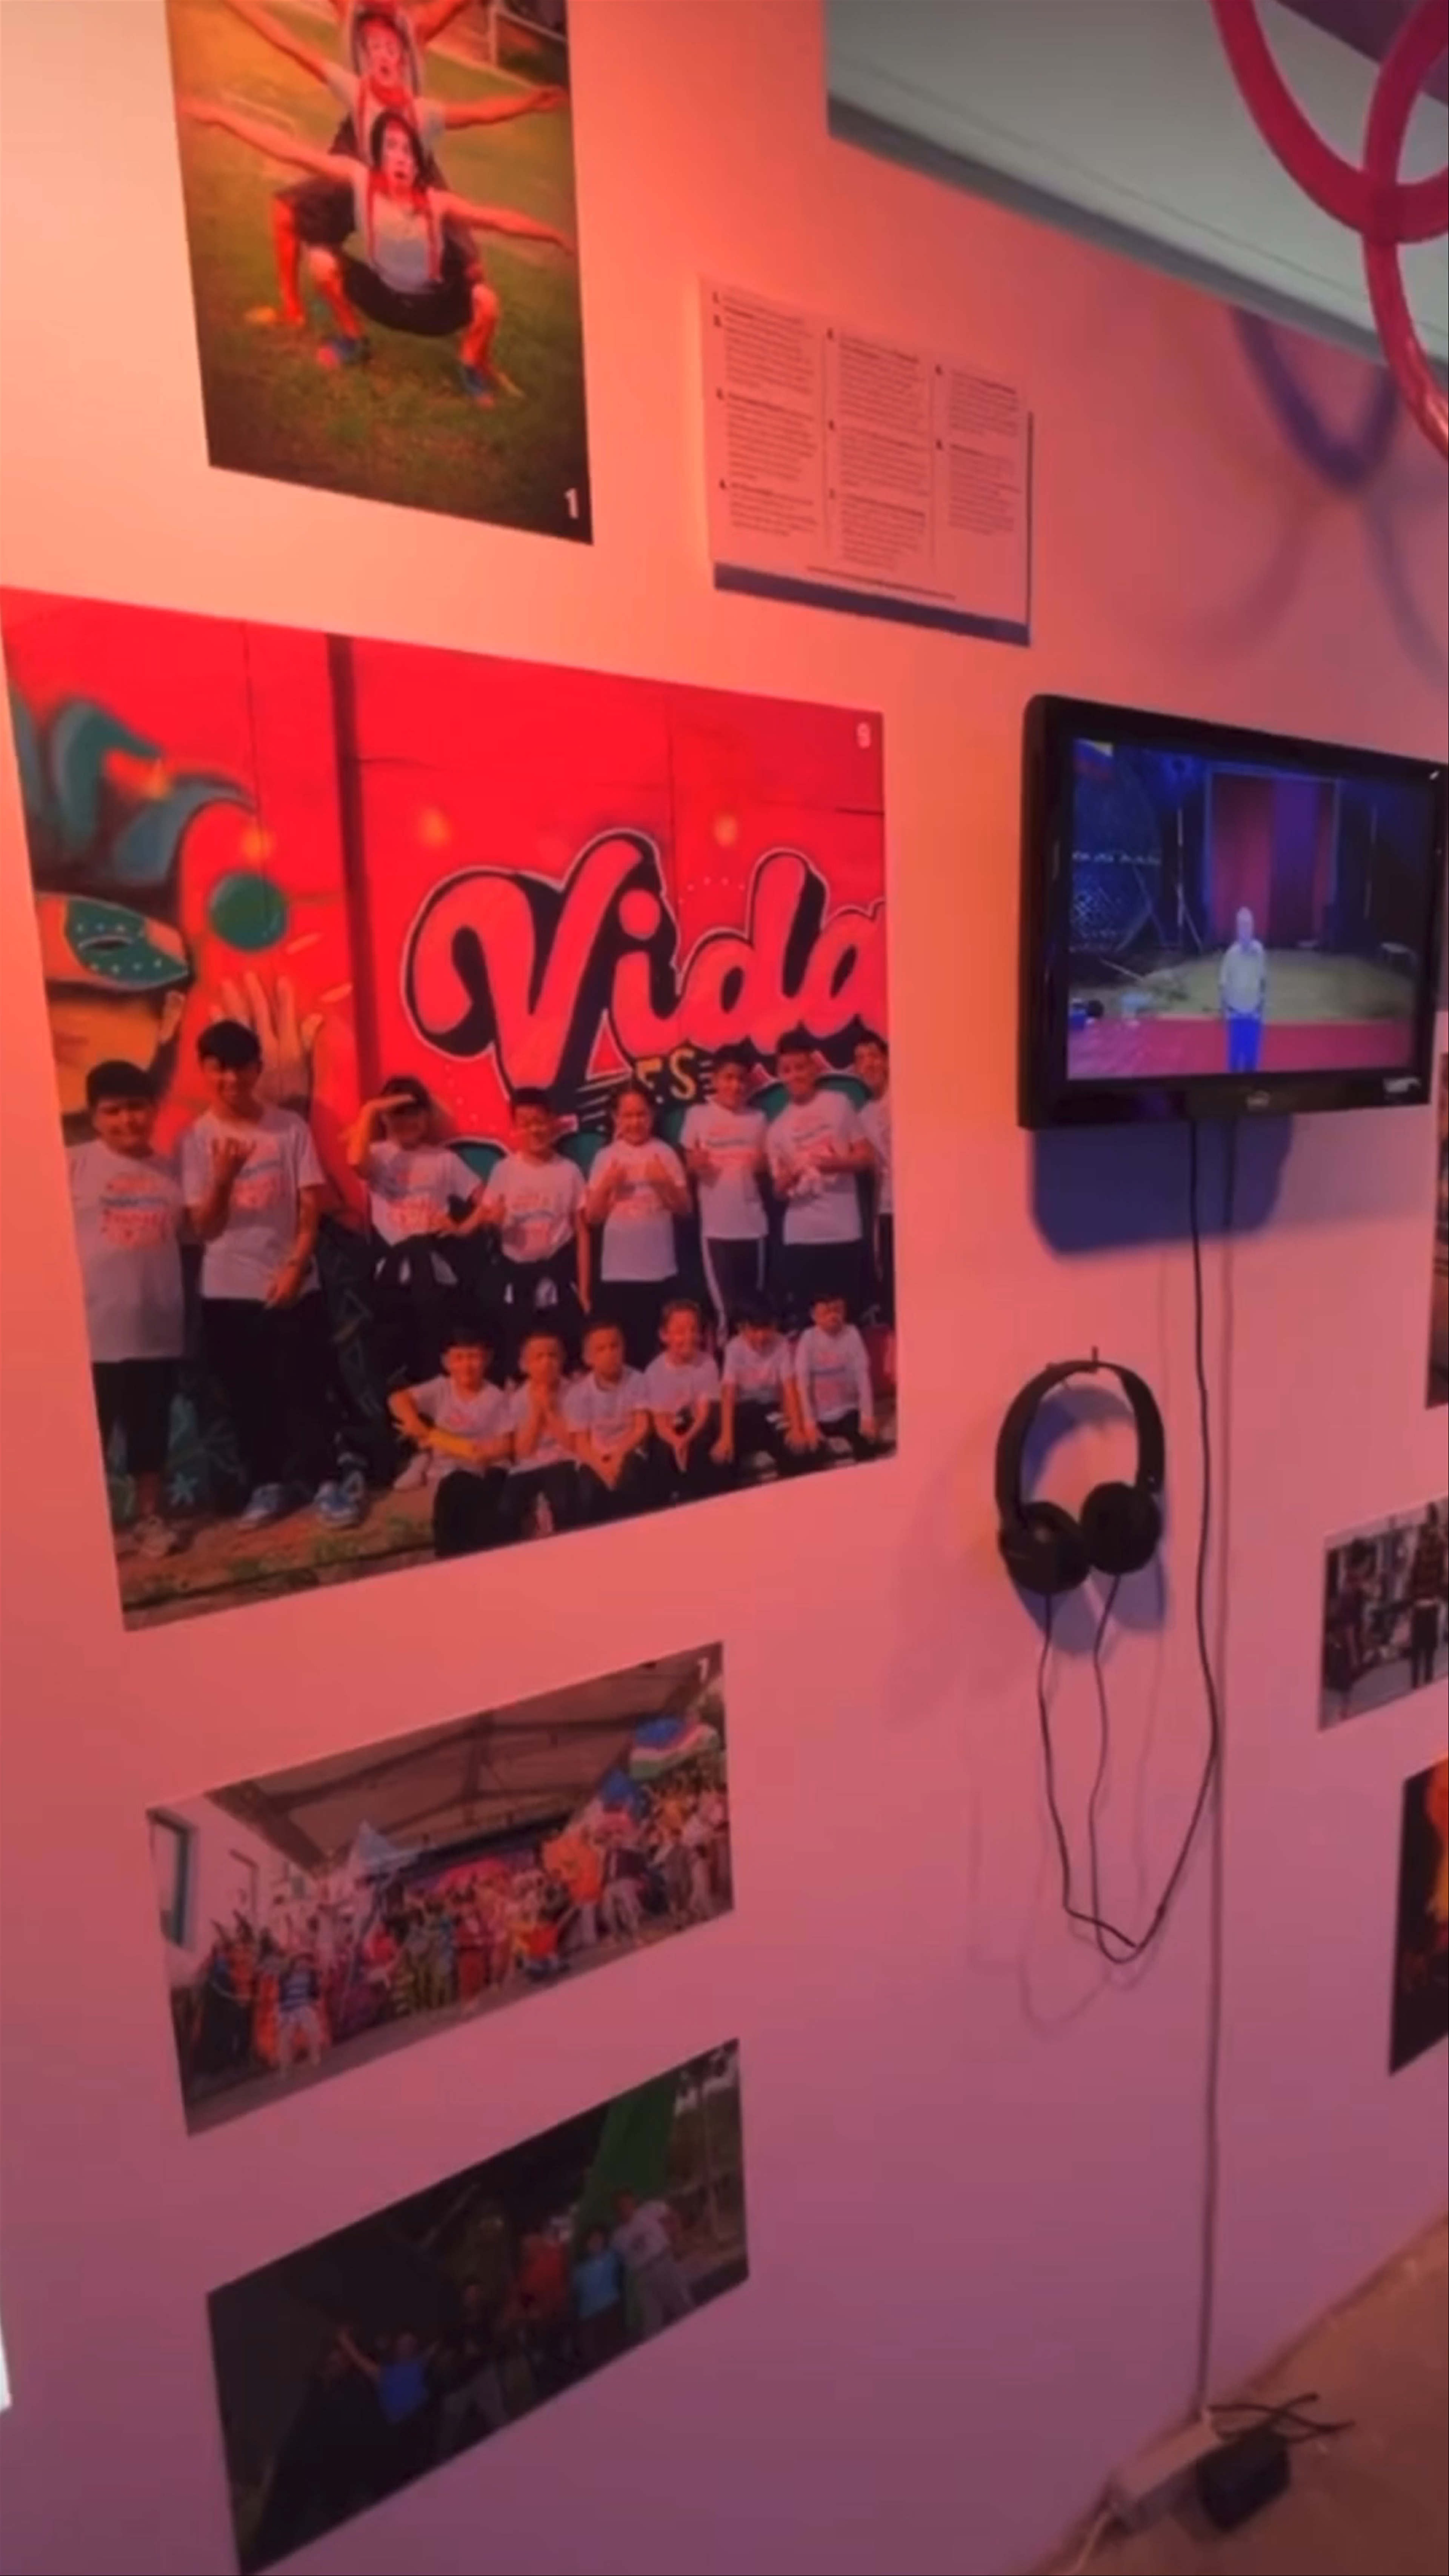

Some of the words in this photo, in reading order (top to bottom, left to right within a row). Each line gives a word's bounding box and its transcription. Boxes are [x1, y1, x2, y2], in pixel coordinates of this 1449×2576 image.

[565, 487, 579, 518] 1
[857, 722, 871, 748] 9
[401, 829, 888, 1091] Vida
